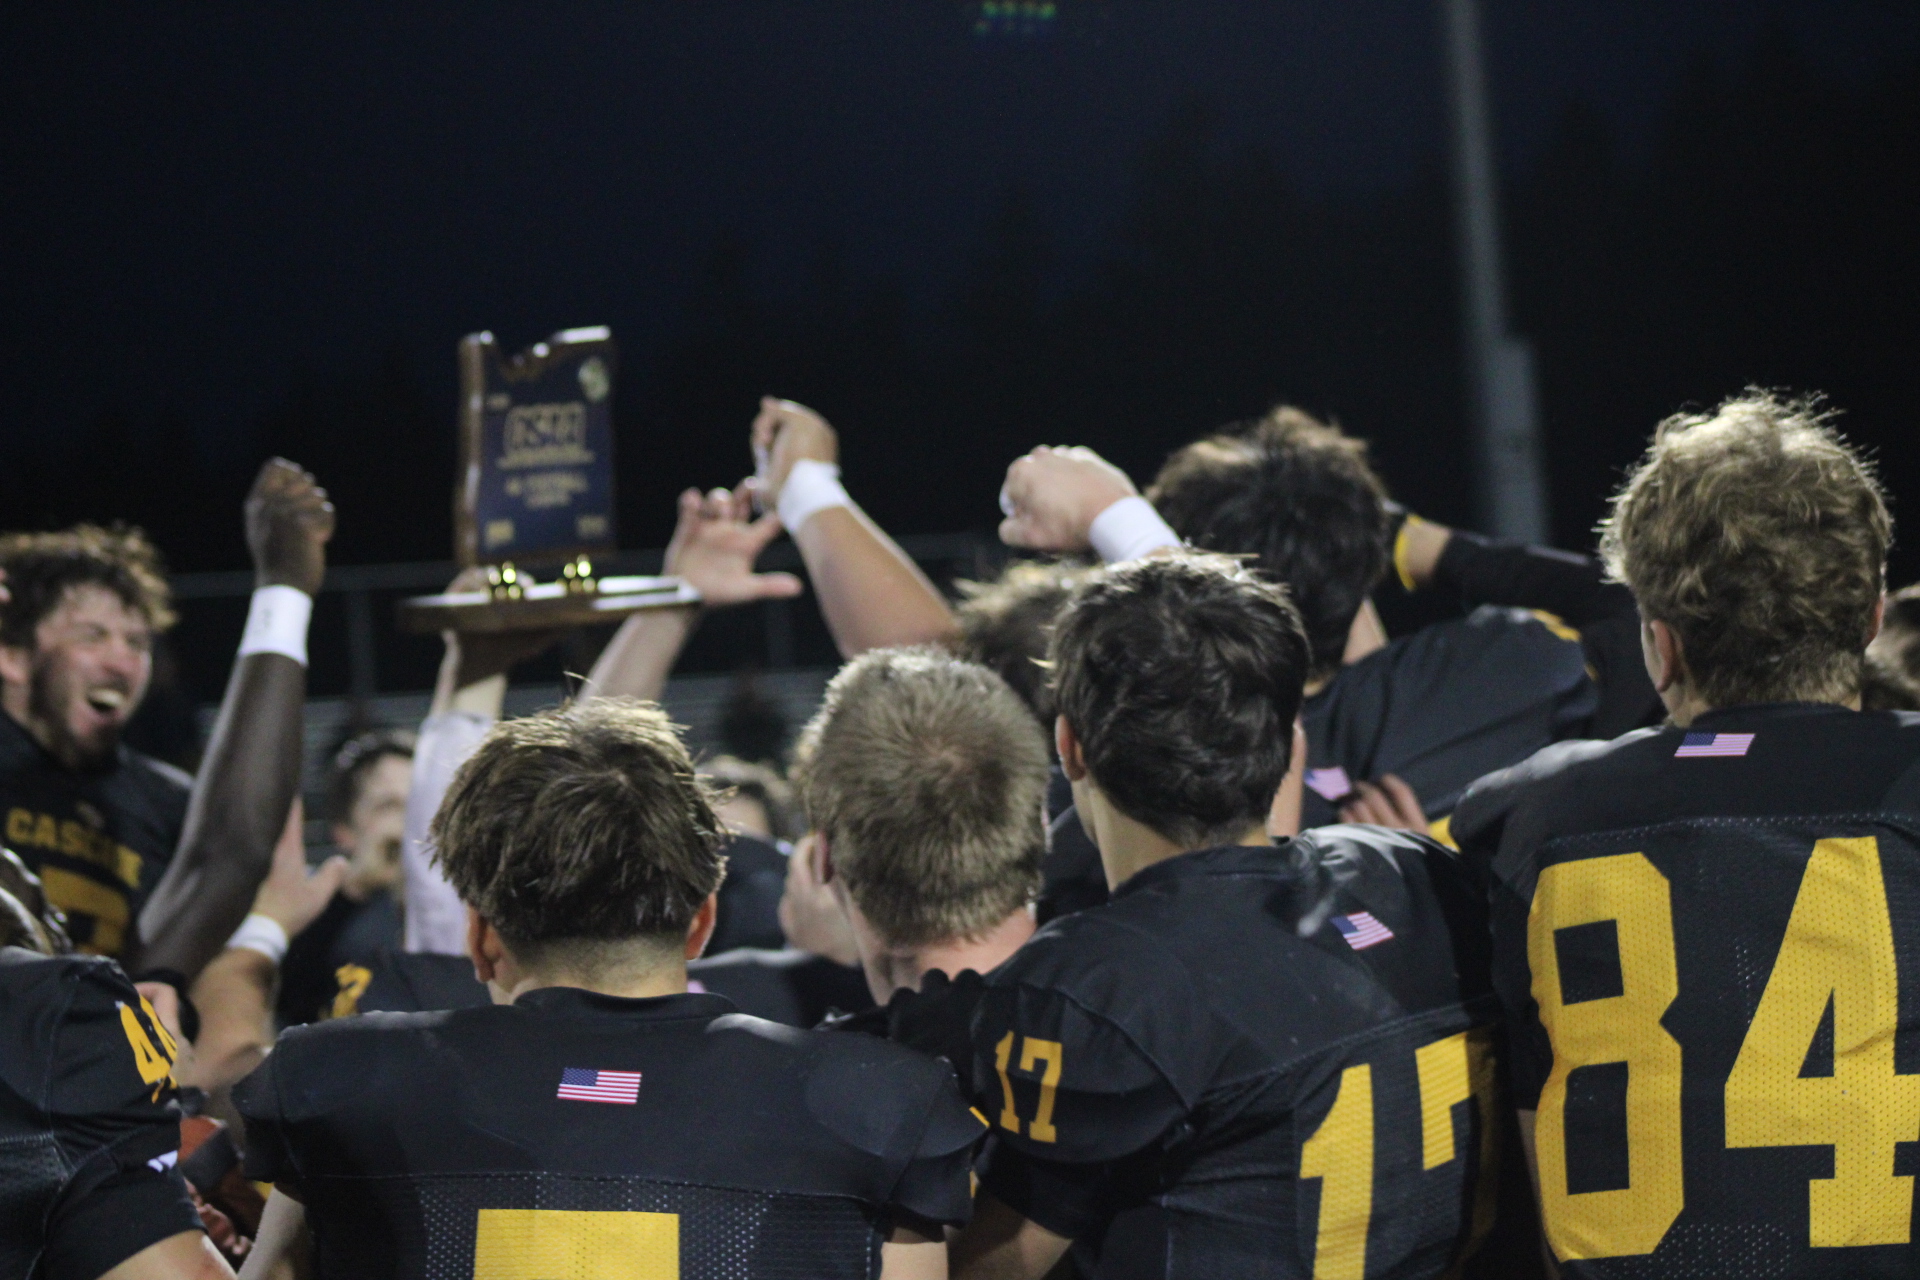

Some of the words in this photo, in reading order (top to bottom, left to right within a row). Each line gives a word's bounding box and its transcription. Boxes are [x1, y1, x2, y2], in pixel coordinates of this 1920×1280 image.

[995, 1029, 1063, 1143] 17
[1300, 1028, 1497, 1280] 17
[1527, 836, 1920, 1263] 84
